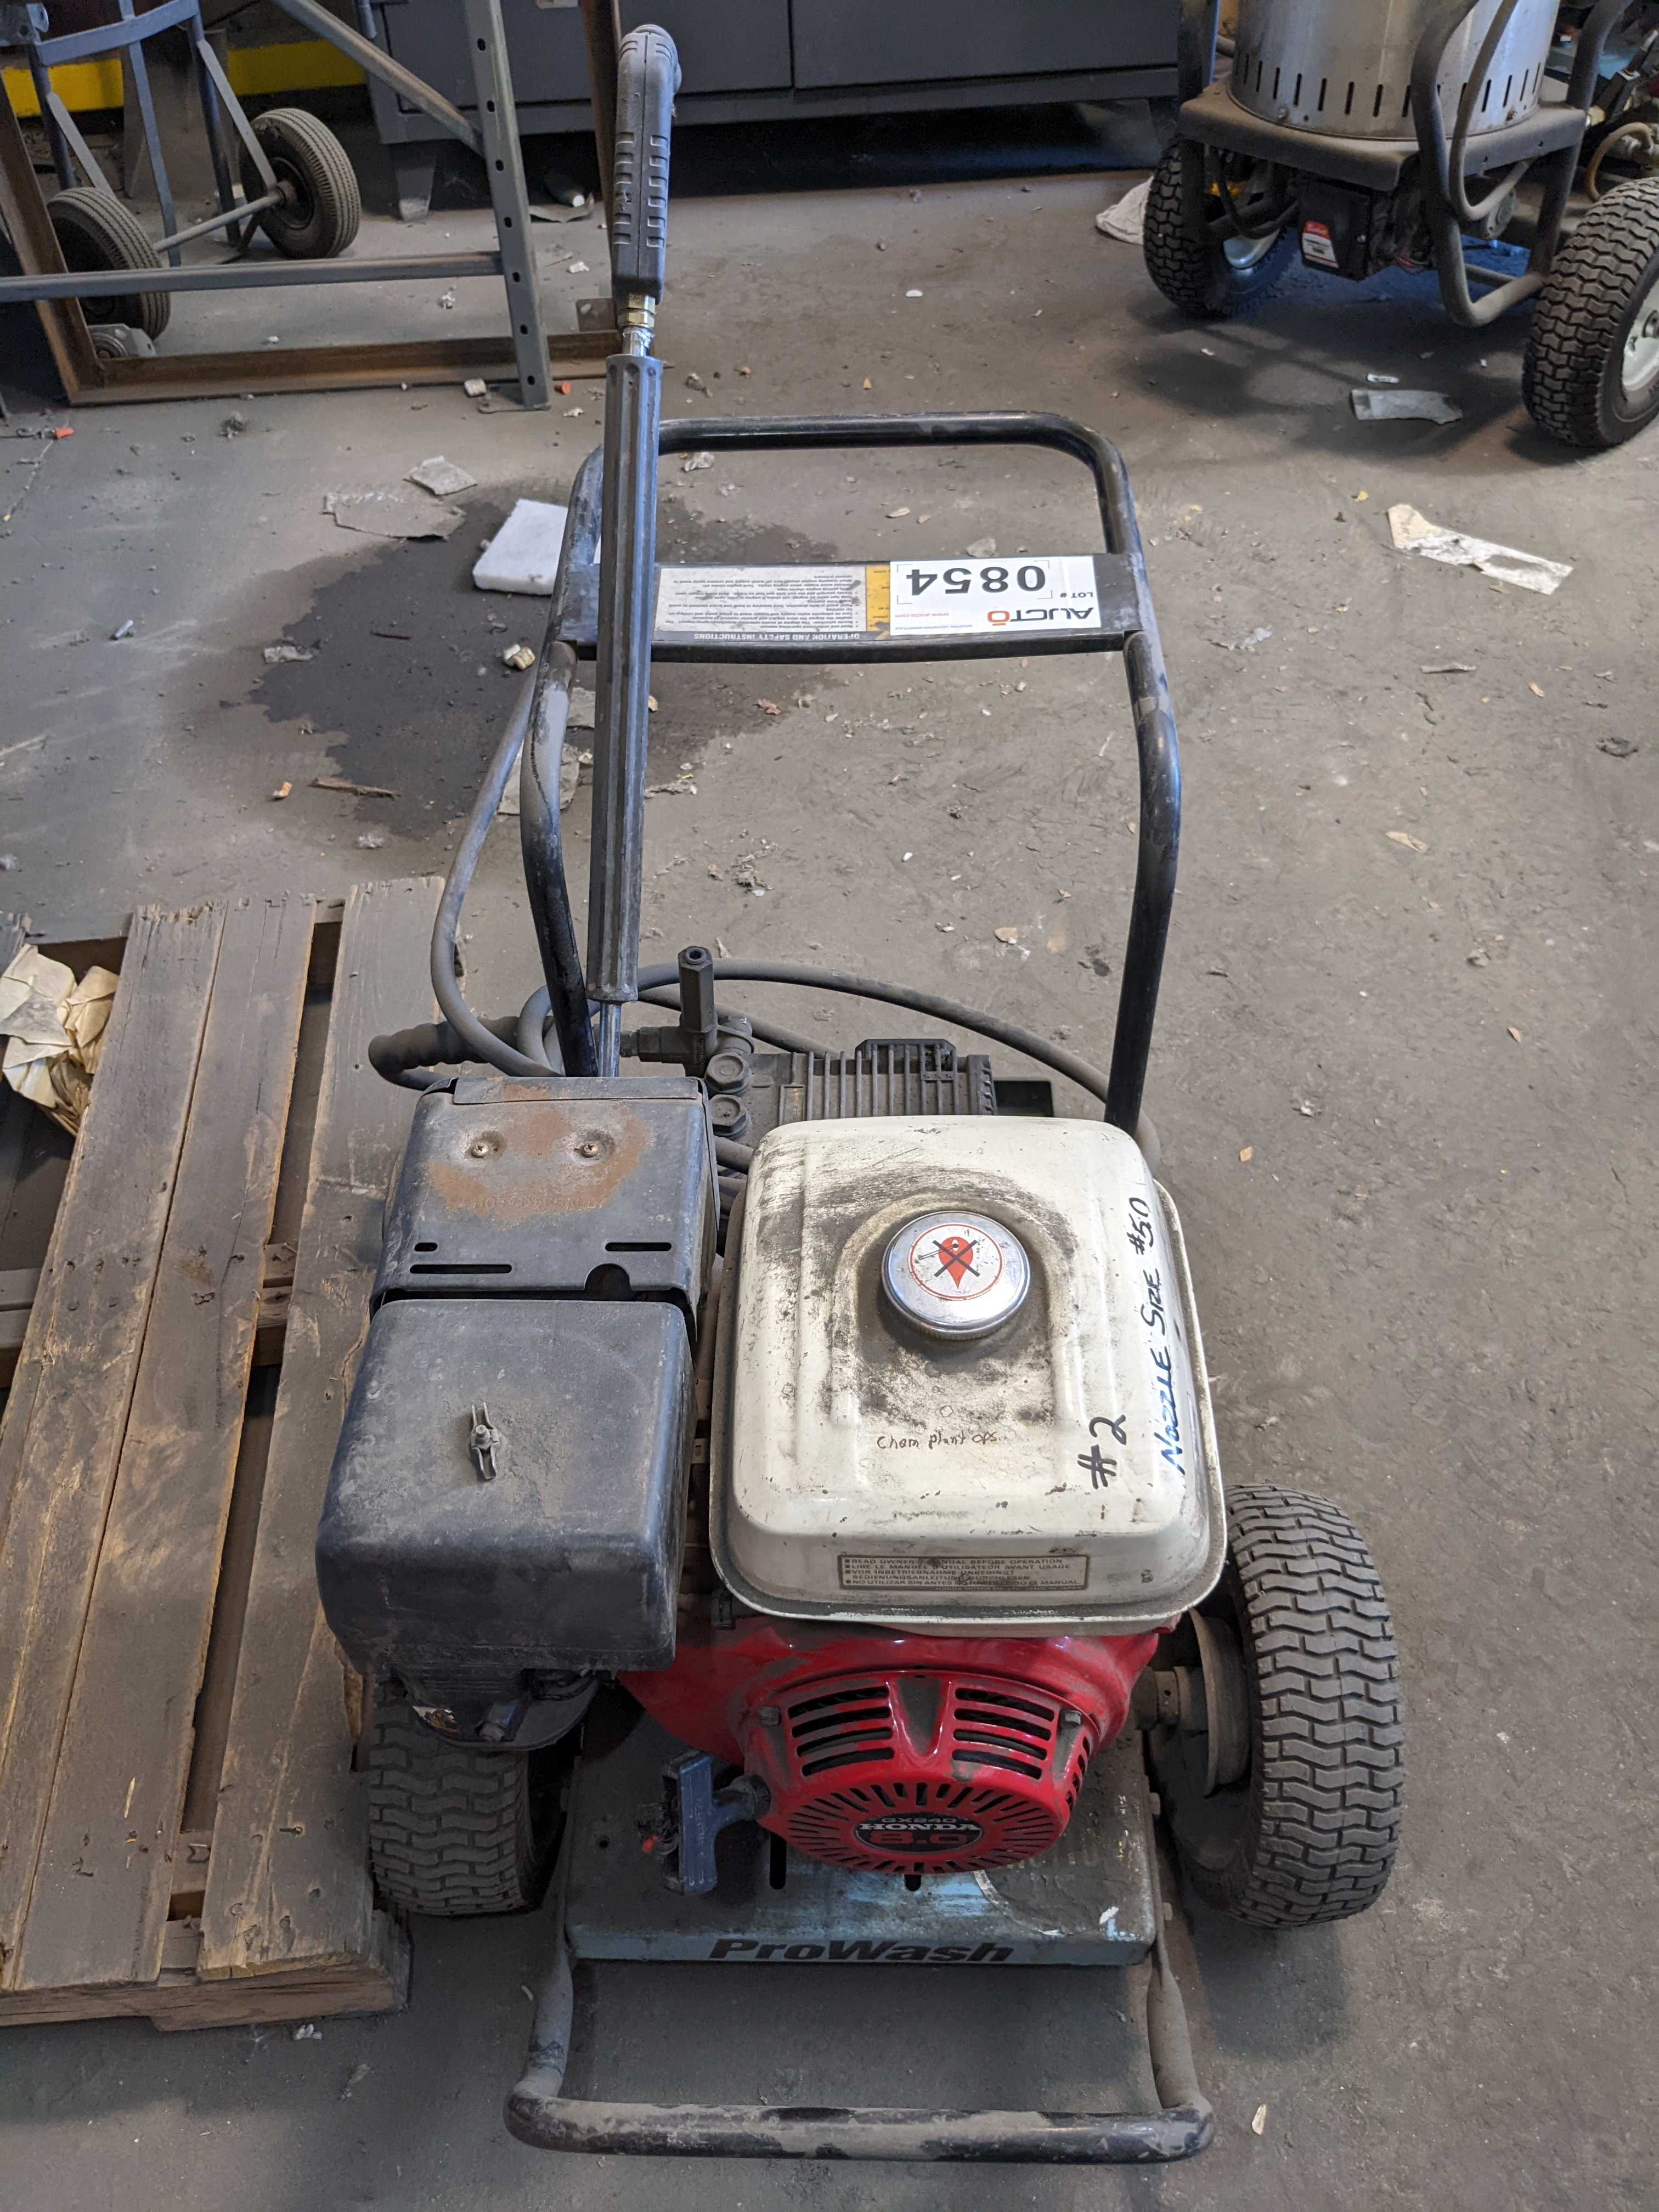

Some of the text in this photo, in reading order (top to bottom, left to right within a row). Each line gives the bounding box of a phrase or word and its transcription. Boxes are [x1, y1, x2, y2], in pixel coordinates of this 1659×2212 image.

[905, 566, 1046, 596] 0854
[1077, 1414, 1127, 1490] #2
[708, 1938, 1014, 1962] ProWash
